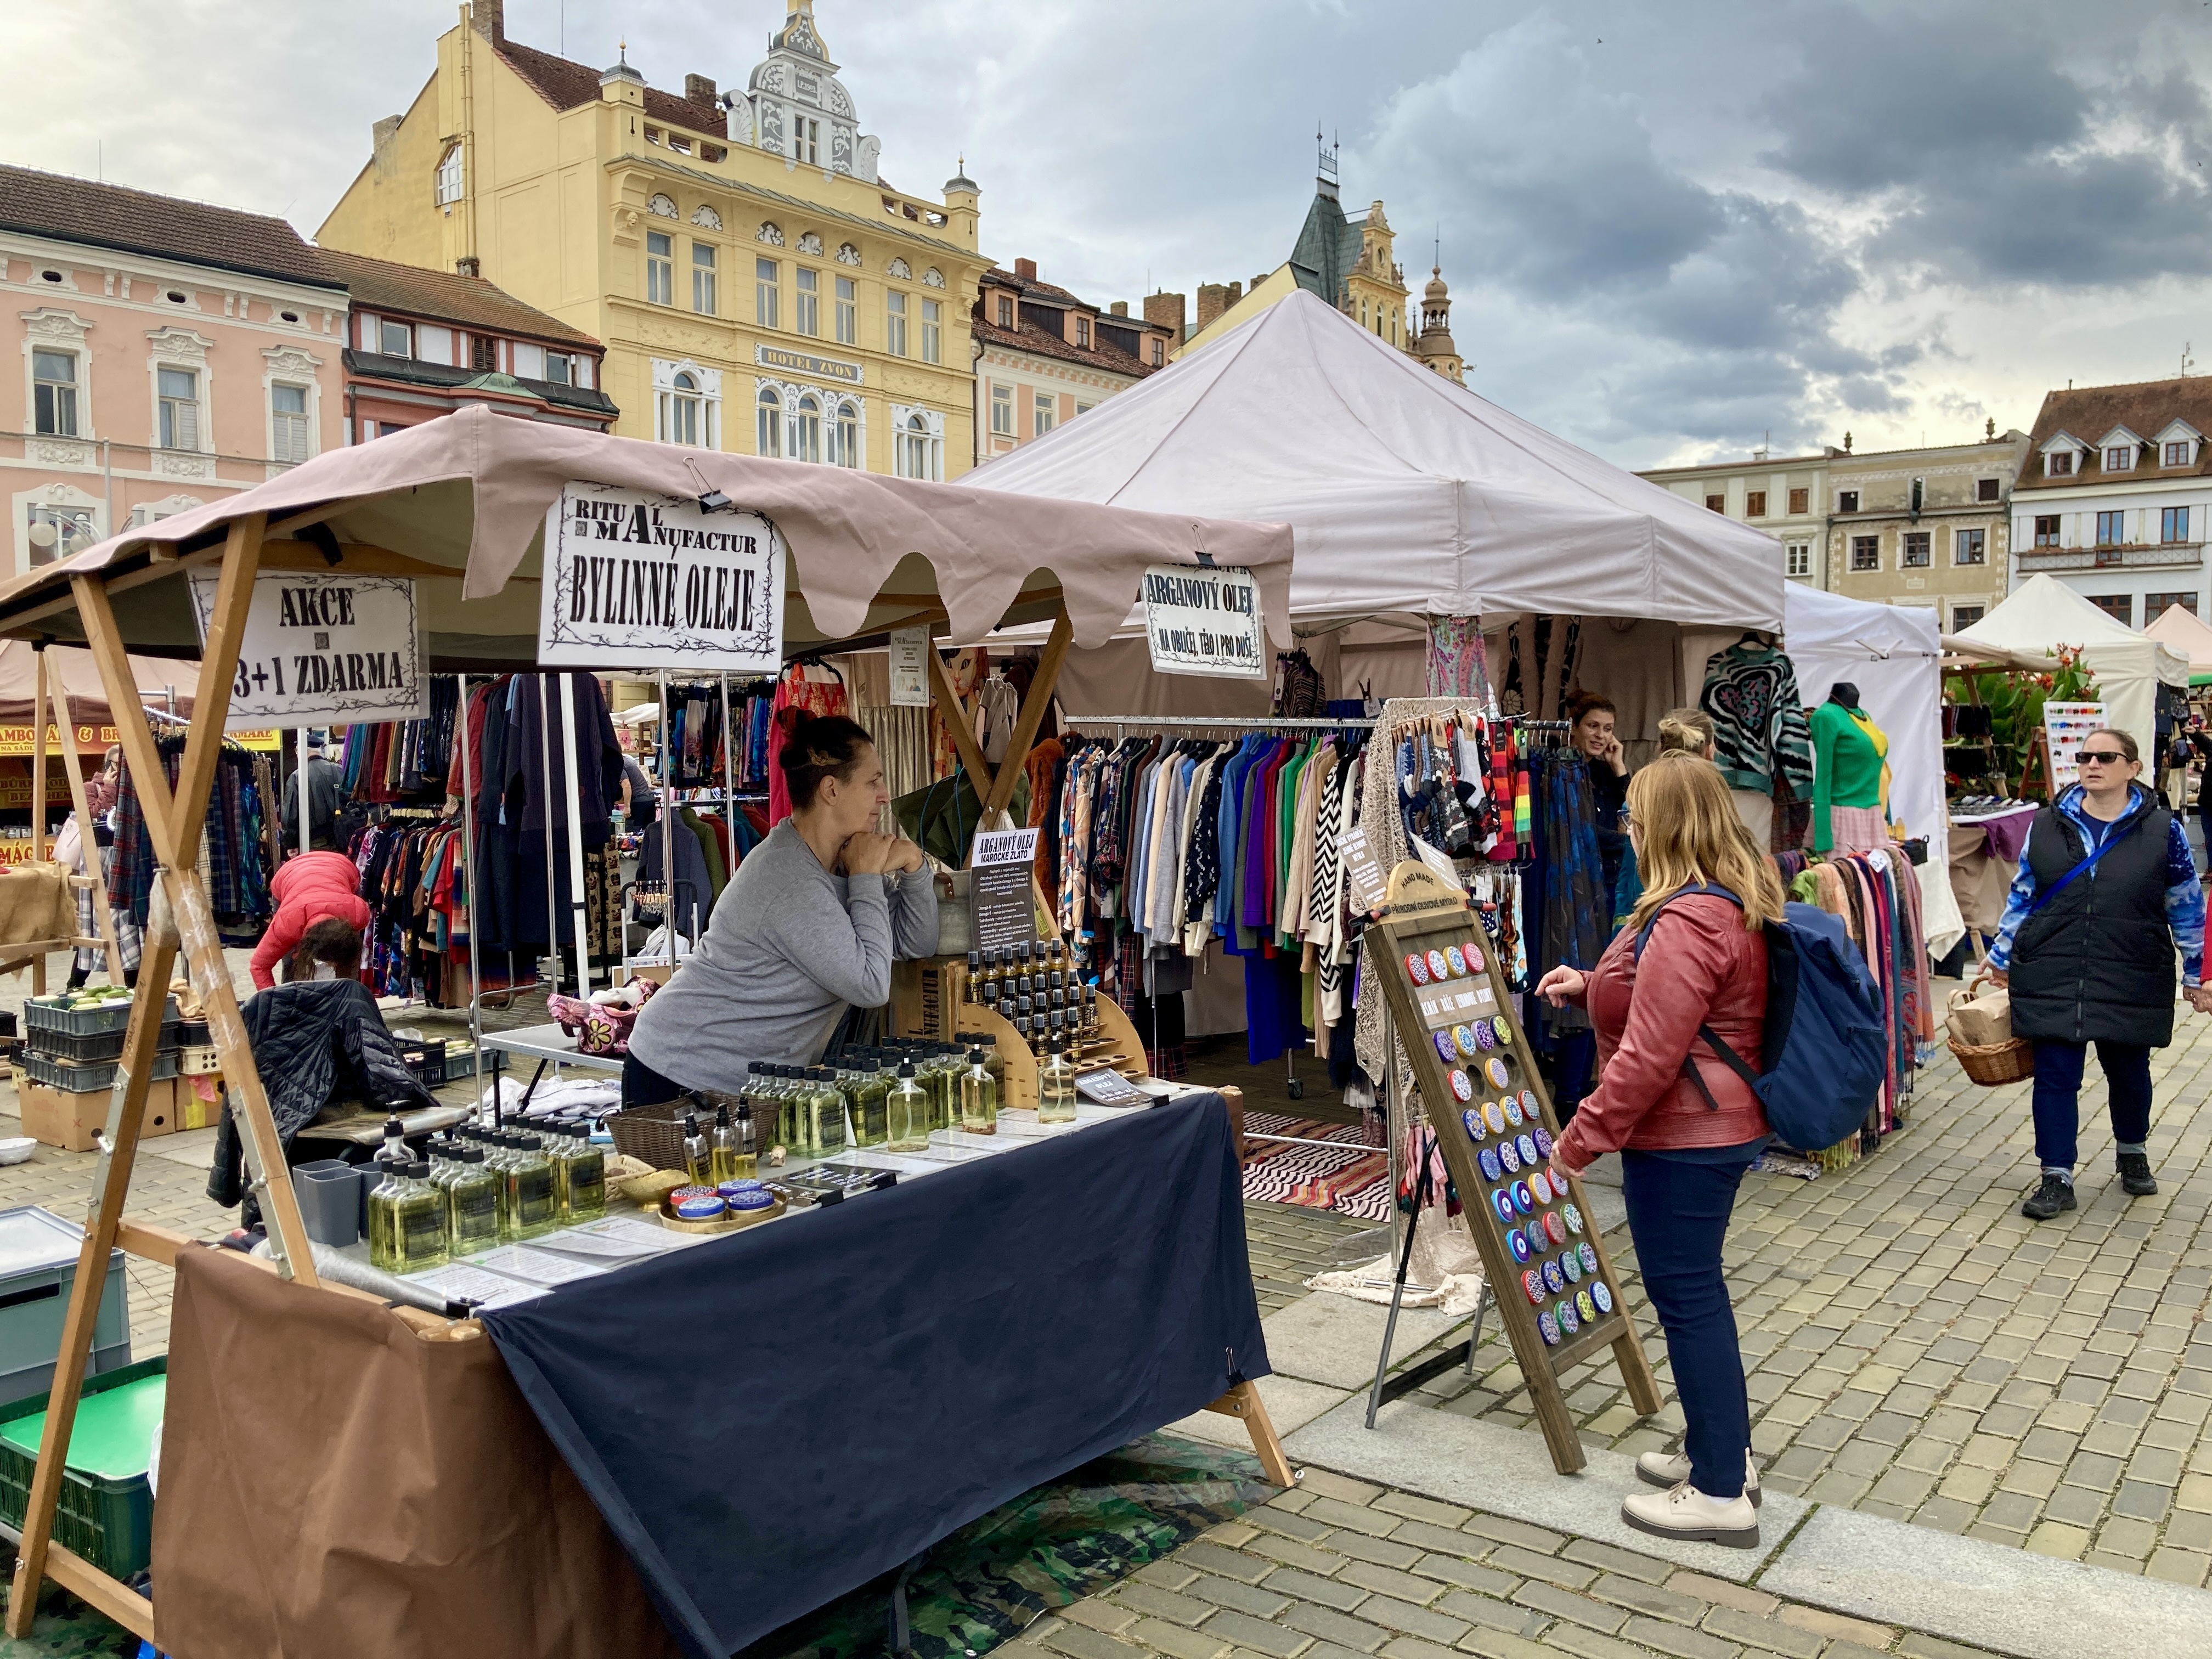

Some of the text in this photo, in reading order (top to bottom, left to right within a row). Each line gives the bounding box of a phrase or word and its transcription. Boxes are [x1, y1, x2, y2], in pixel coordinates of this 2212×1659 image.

[768, 351, 853, 377] HOTEL ZVON
[279, 588, 355, 627] AKCE
[686, 563, 755, 631] OLEJE
[1146, 574, 1251, 617] ARGANOVÝ OLEJ
[1159, 628, 1170, 651] NA
[1199, 628, 1214, 656] TĚLO
[1220, 634, 1234, 657] PRO
[234, 652, 404, 698] 3+1 ZDARMA
[80, 727, 91, 741] &
[979, 832, 1035, 854] ARGANOVÝ OLEJ
[1009, 850, 1028, 860] ZLATO
[1401, 873, 1415, 890] HAND
[1415, 872, 1434, 886] MADE
[1391, 895, 1458, 915] PŘÍRODNÍ OLIVOVÉ MÝDLO
[923, 969, 939, 1037] NUFACTUR
[1078, 1072, 1112, 1086] ARGANOVÝ
